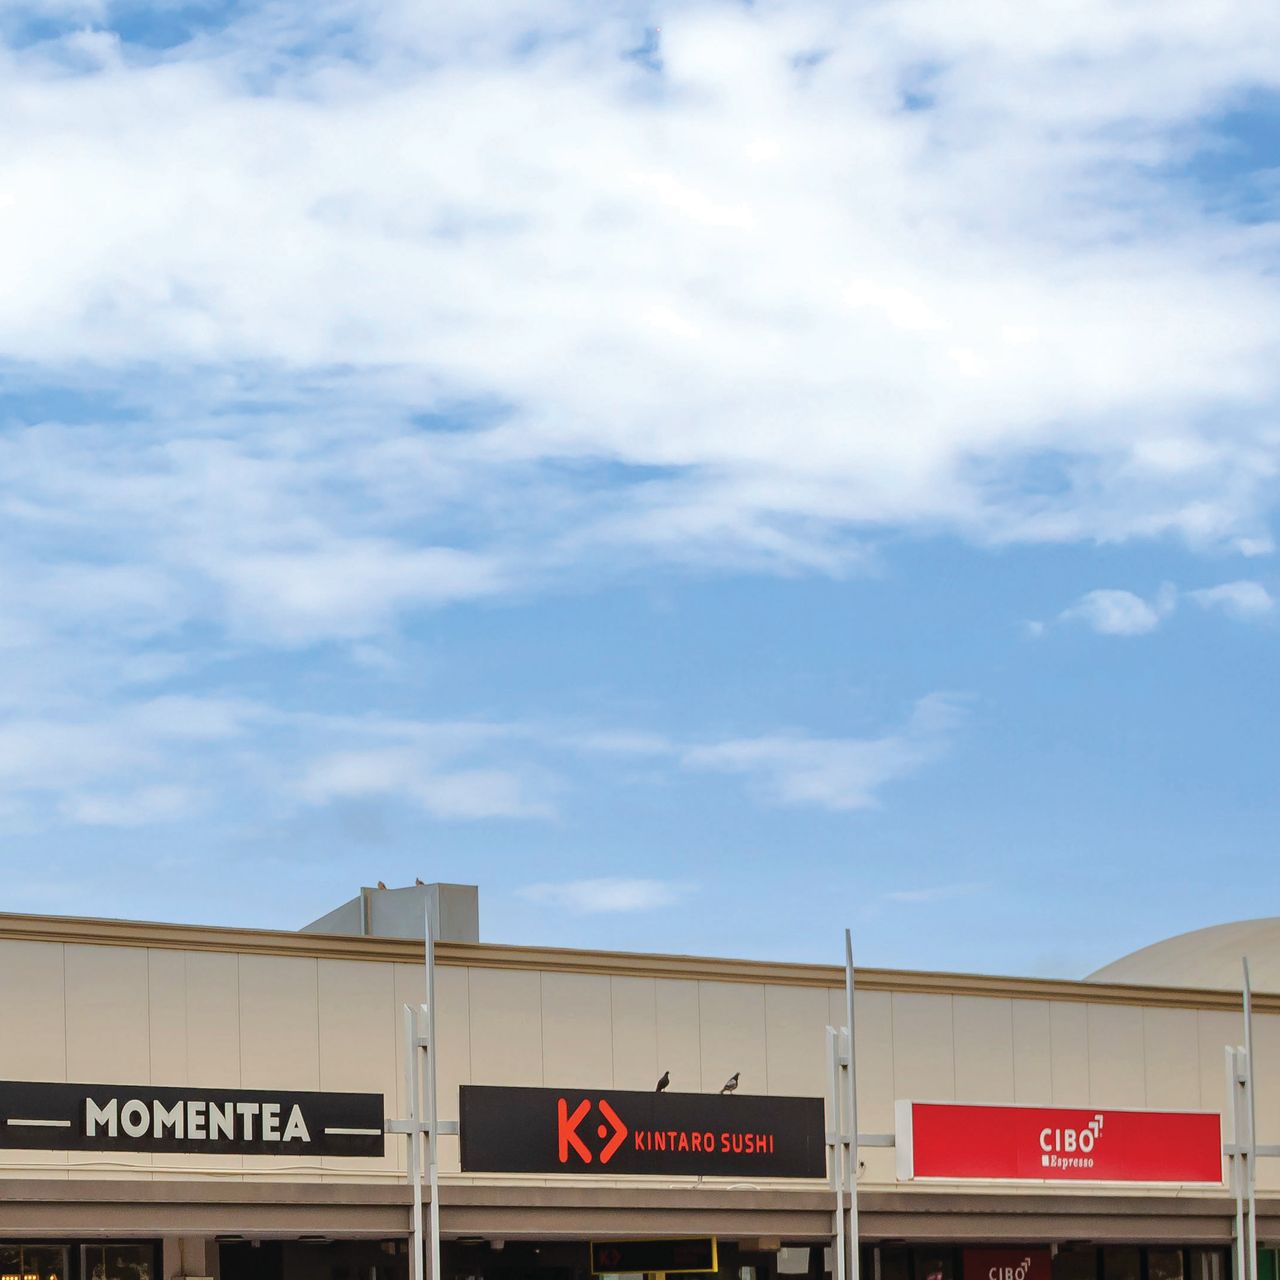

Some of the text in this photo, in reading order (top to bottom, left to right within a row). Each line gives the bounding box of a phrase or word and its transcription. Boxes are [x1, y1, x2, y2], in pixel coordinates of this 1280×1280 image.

[86, 1097, 311, 1142] MOMENTEA
[635, 1131, 715, 1152] KINTARO
[720, 1132, 774, 1153] SUSHI
[1040, 1128, 1094, 1152] CIBO
[1051, 1155, 1093, 1170] Espresso
